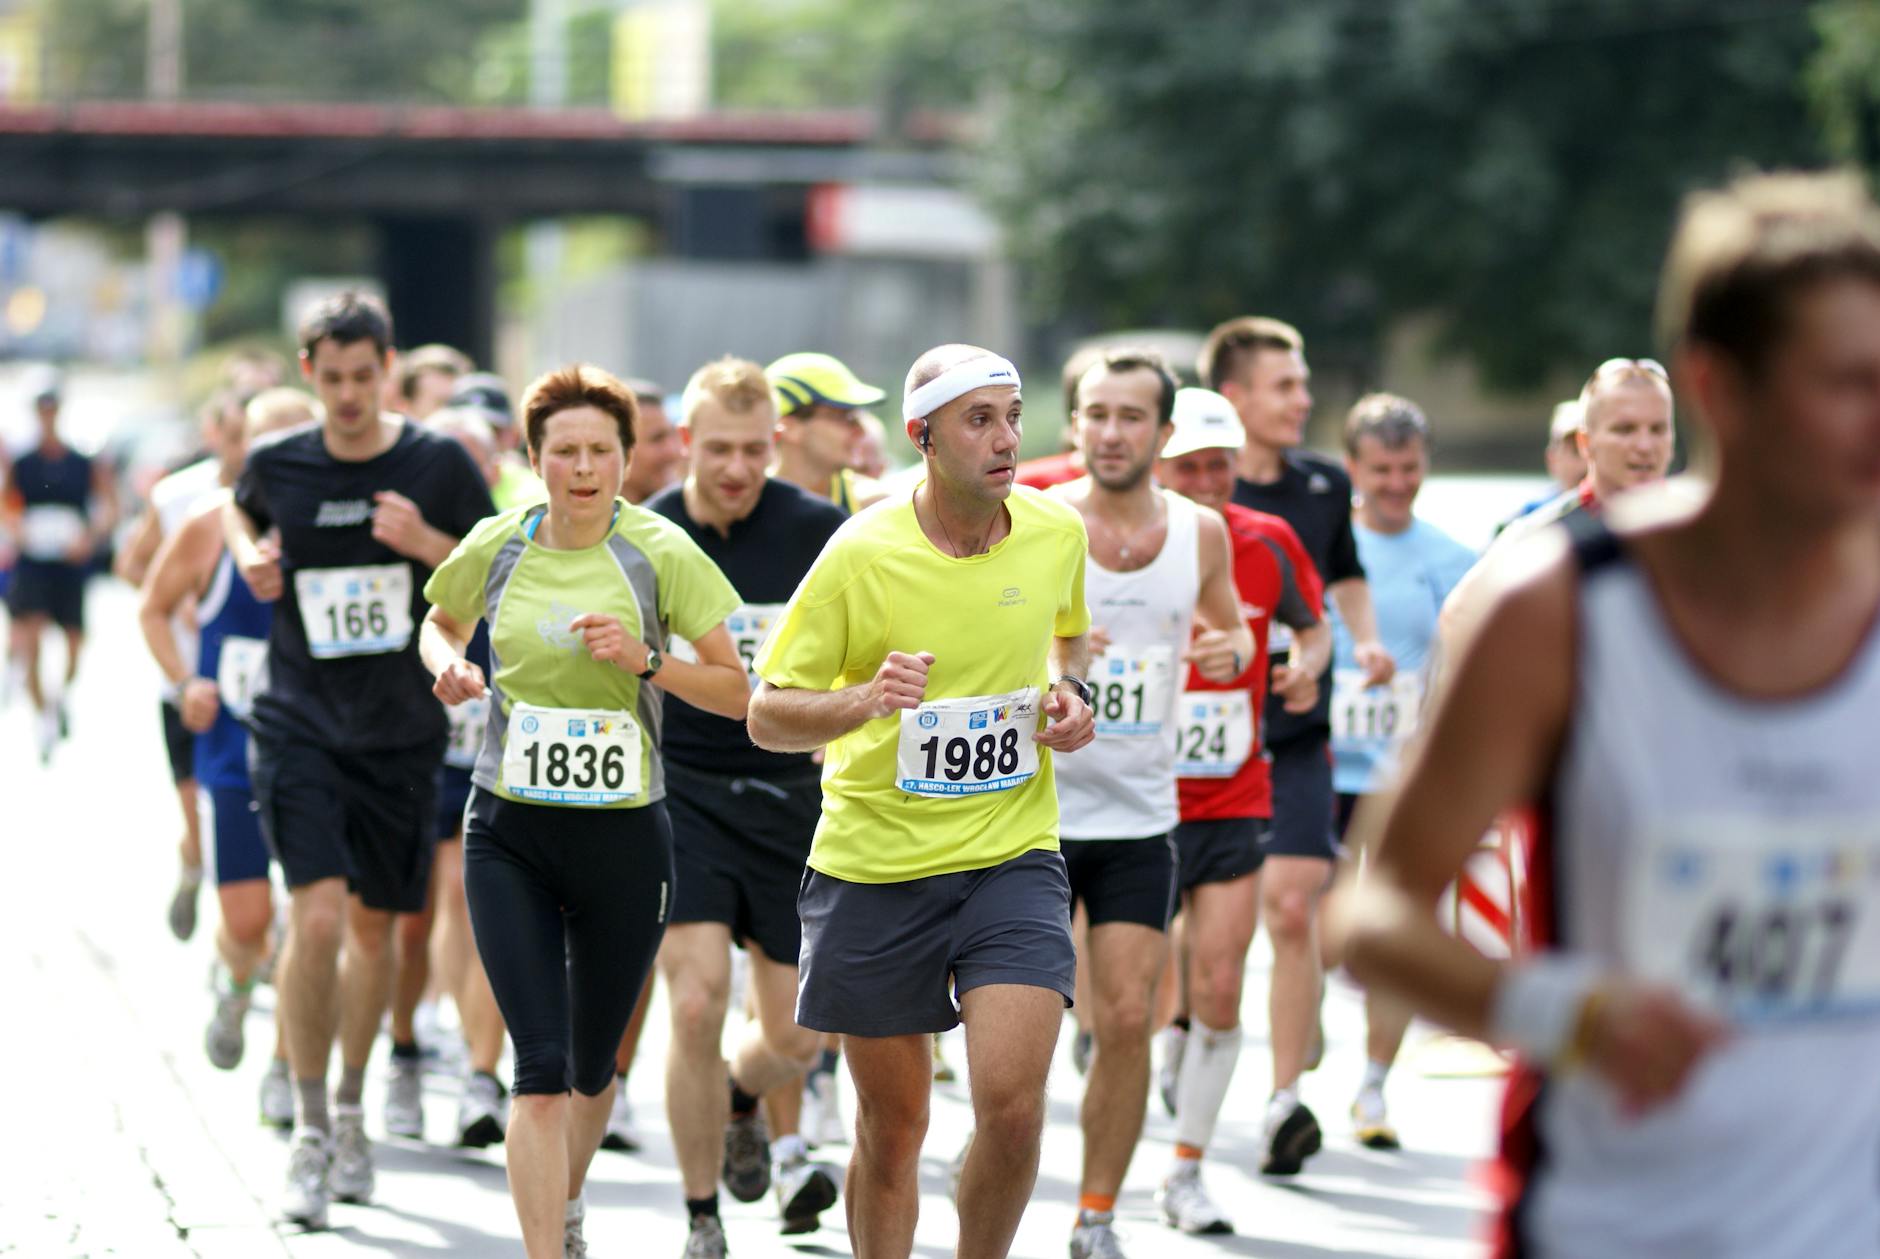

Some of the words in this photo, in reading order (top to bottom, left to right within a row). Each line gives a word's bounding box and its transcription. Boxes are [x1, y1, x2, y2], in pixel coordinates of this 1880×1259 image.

[326, 601, 388, 640] 166
[524, 742, 624, 789] 1836
[920, 728, 1018, 781] 1988
